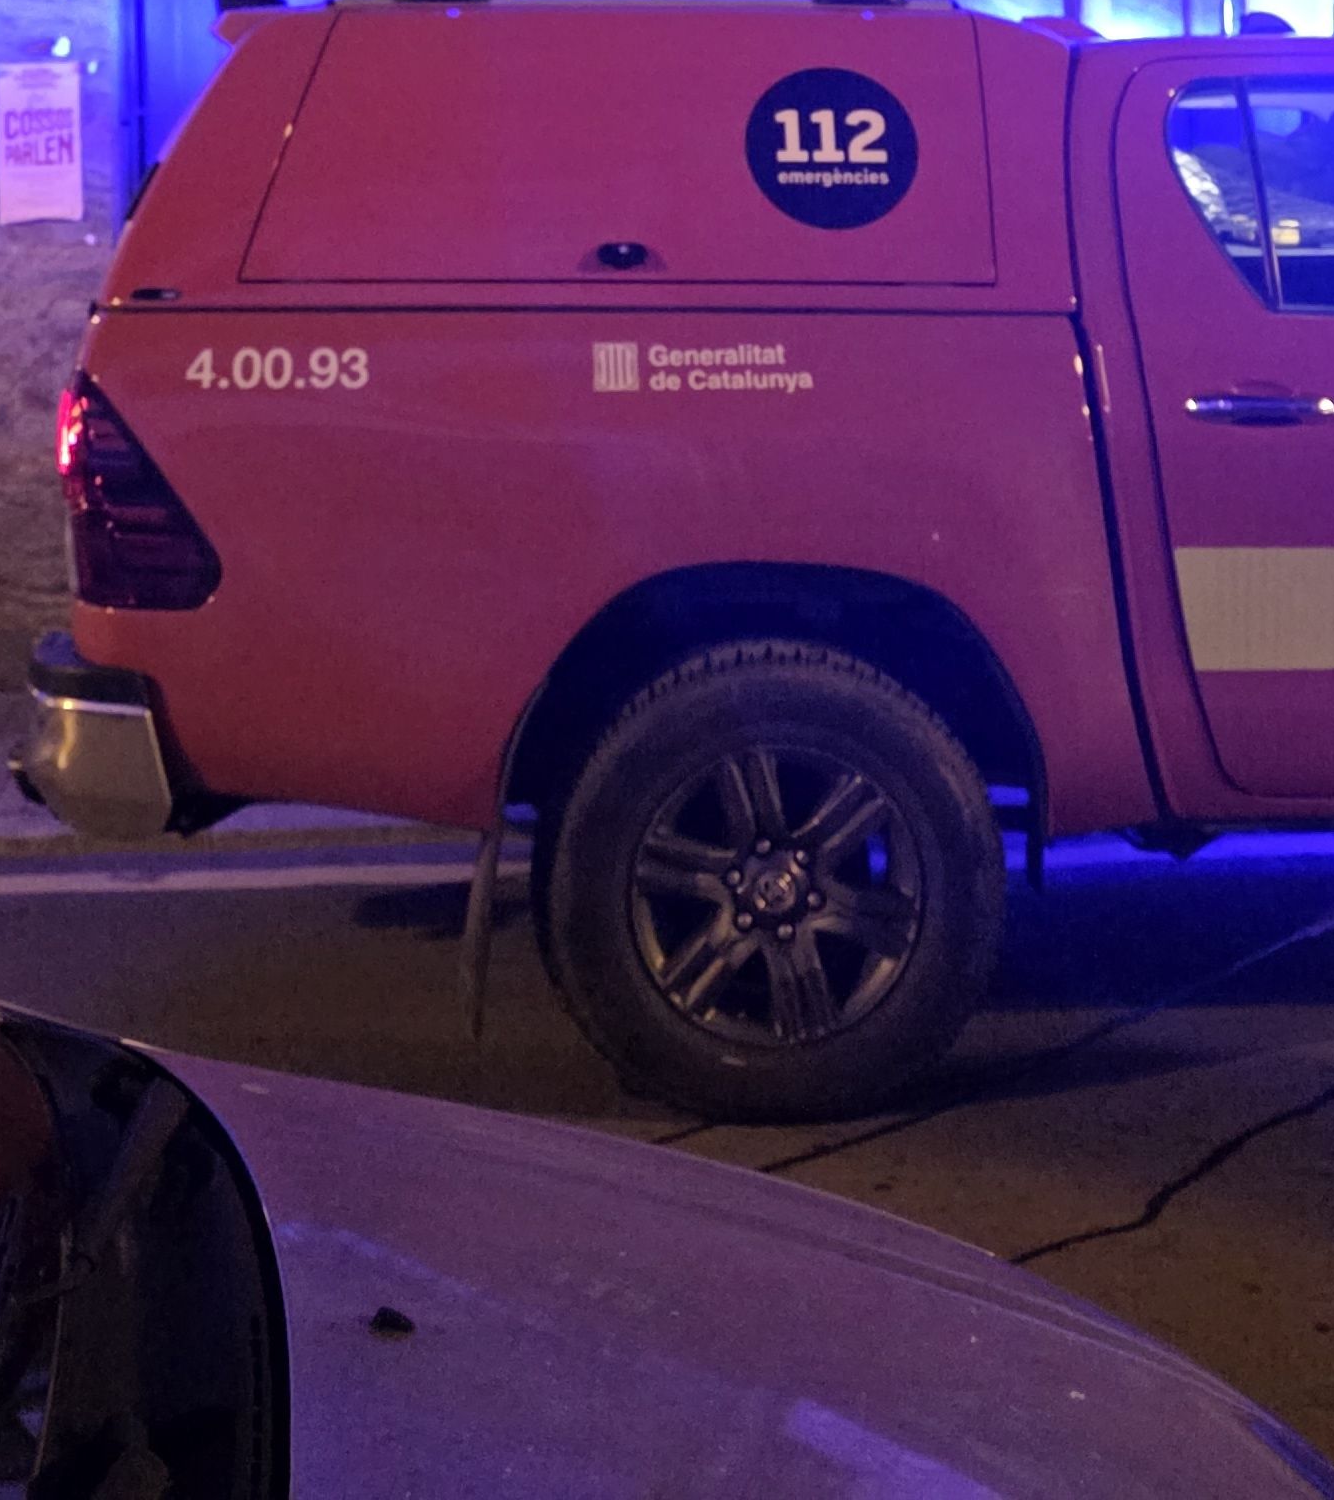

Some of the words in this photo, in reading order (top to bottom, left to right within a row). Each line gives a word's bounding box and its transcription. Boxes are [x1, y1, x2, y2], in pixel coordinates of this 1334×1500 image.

[774, 108, 889, 164] 112
[777, 167, 890, 188] emergències
[185, 346, 370, 390] 4.00.93
[647, 343, 786, 367] Generalitat
[648, 370, 682, 391] de
[687, 368, 815, 394] Catalunya
